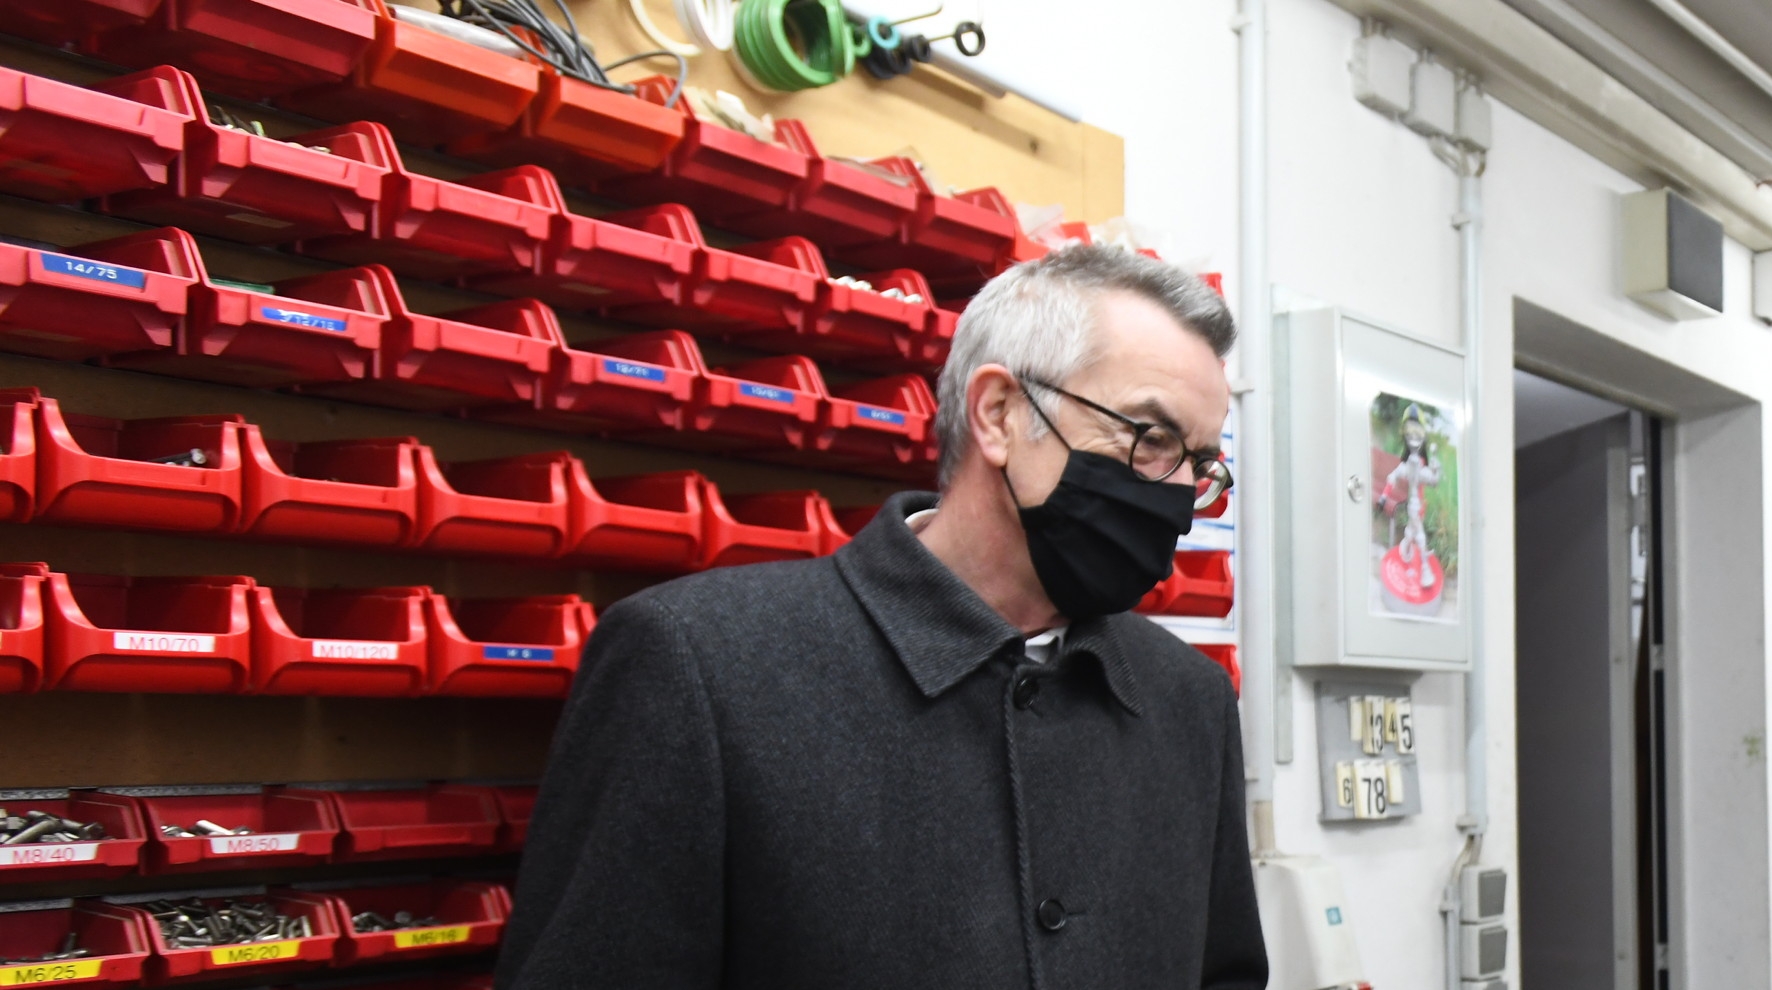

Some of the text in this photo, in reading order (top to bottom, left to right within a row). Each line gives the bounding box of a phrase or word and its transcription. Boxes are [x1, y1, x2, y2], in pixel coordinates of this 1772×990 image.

[66, 261, 118, 280] 14/75
[129, 636, 200, 652] M10/70
[320, 644, 390, 659] M10/120
[227, 837, 280, 853] M8/50
[13, 847, 75, 864] M8/40
[227, 945, 280, 962] M6/20
[15, 964, 76, 983] M6/25
